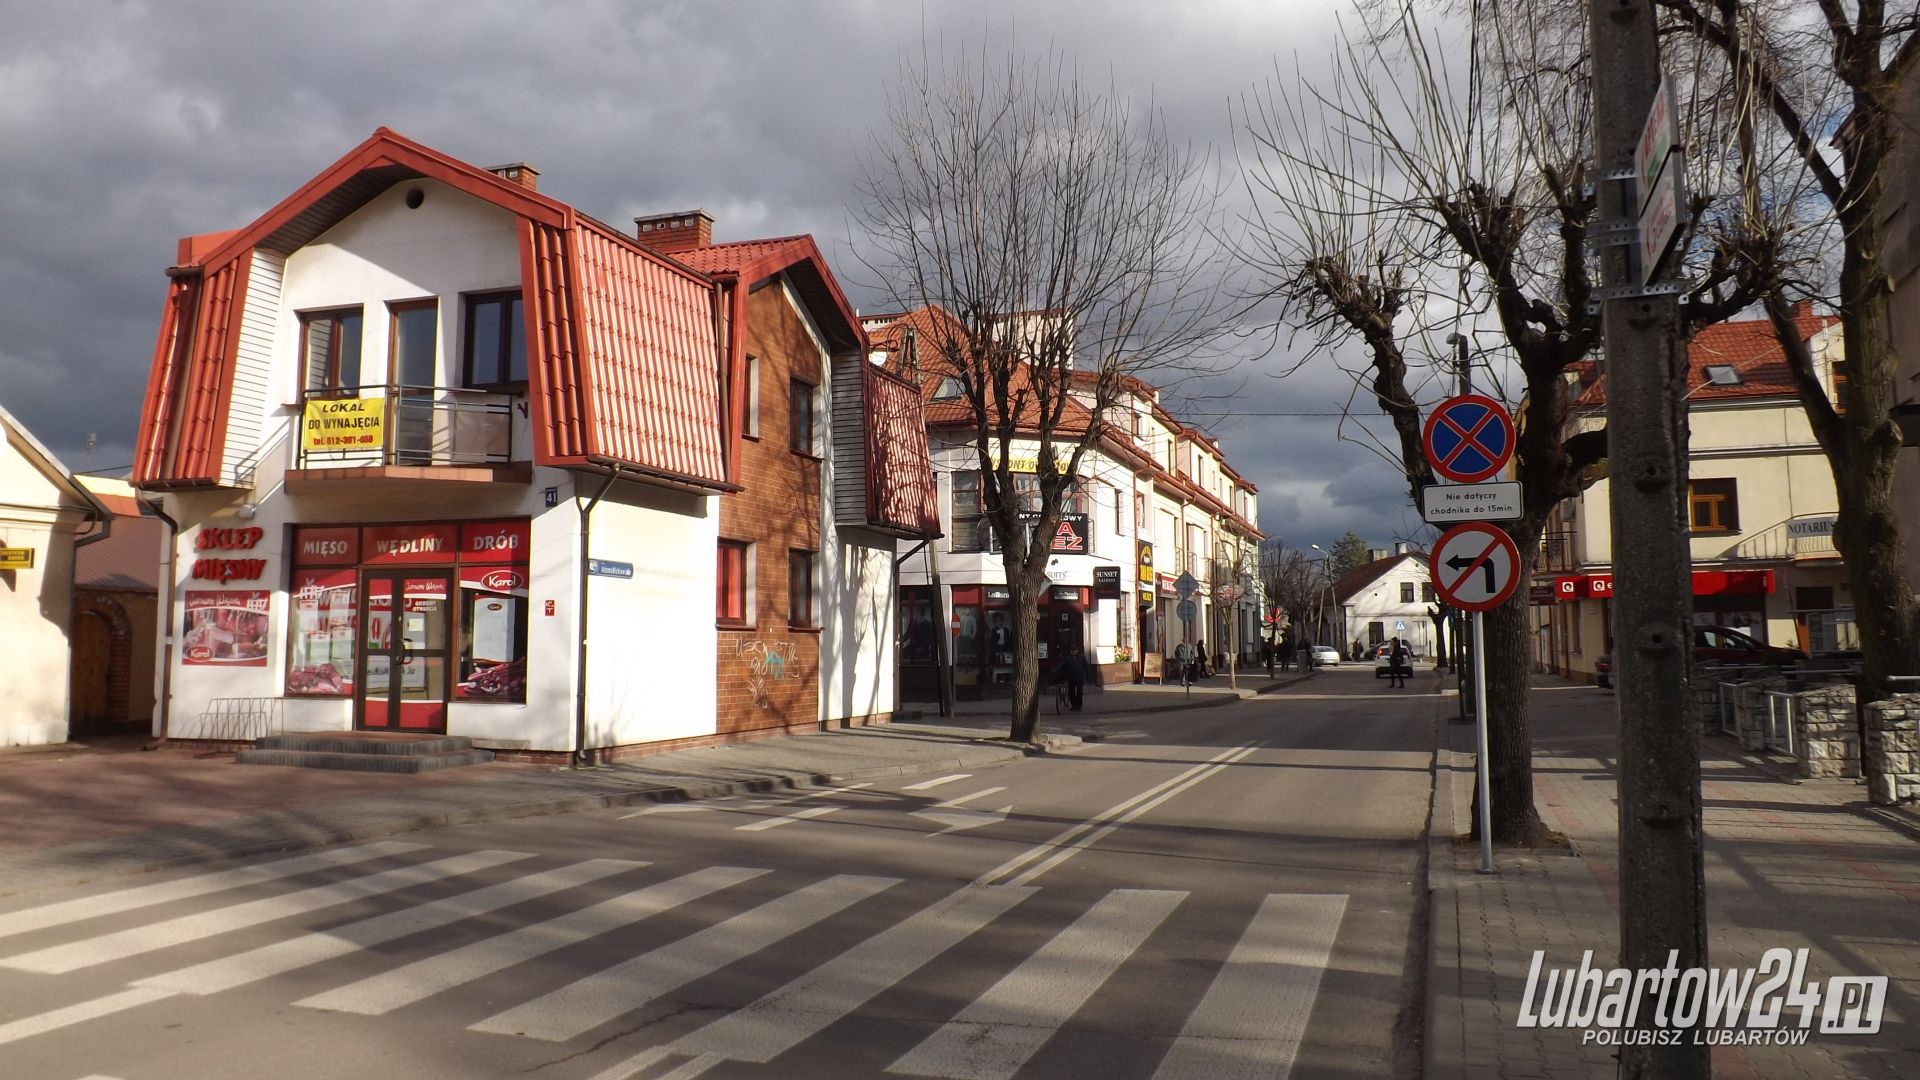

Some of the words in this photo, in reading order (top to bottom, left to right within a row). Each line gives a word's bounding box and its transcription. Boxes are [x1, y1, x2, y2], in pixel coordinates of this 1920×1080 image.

[322, 402, 365, 413] LOKAL
[308, 419, 320, 430] DO
[323, 416, 380, 431] WYNAJĘCIA
[546, 490, 557, 503] 41
[1446, 493, 1461, 501] Nie
[1463, 491, 1497, 503] dotyczy
[1430, 506, 1470, 515] chodnika
[1473, 505, 1485, 513] do
[1788, 521, 1838, 535] NOTARIUS
[194, 527, 264, 550] SKLEP
[303, 541, 348, 558] MIĘSO
[376, 537, 444, 557] WĘDLINY
[473, 529, 520, 551] DRÓB
[191, 558, 266, 586] MIĘSNY
[488, 575, 517, 589] Karol
[190, 648, 210, 658] Karol
